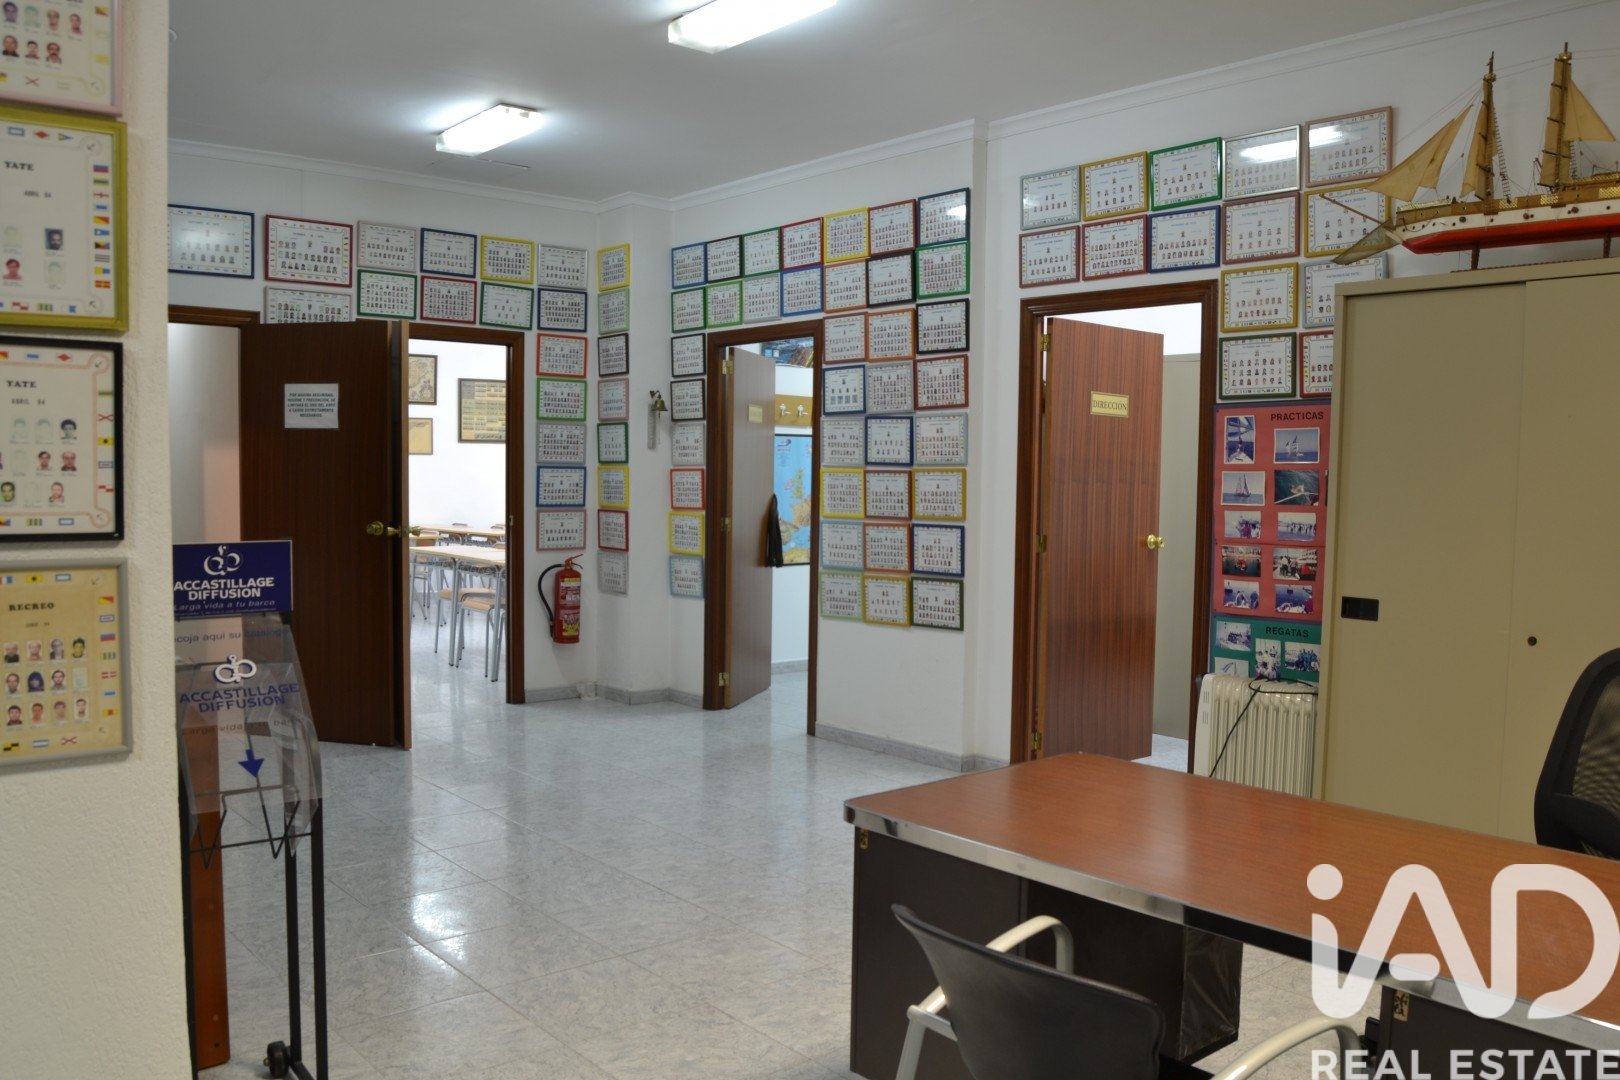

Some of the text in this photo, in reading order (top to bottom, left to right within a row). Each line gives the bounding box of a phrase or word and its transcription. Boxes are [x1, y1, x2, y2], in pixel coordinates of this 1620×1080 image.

[4, 161, 34, 171] YATE
[6, 380, 37, 388] YATE
[1270, 411, 1324, 422] PRACTICAS
[174, 577, 275, 591] ACCASTILLAGE
[188, 588, 261, 601] DIFFUSION
[8, 602, 54, 612] RECREO
[229, 631, 241, 639] su
[1265, 626, 1309, 638] REGATAS
[180, 683, 300, 704] ACCASTILLAGE
[198, 696, 287, 713] DIFFUSION
